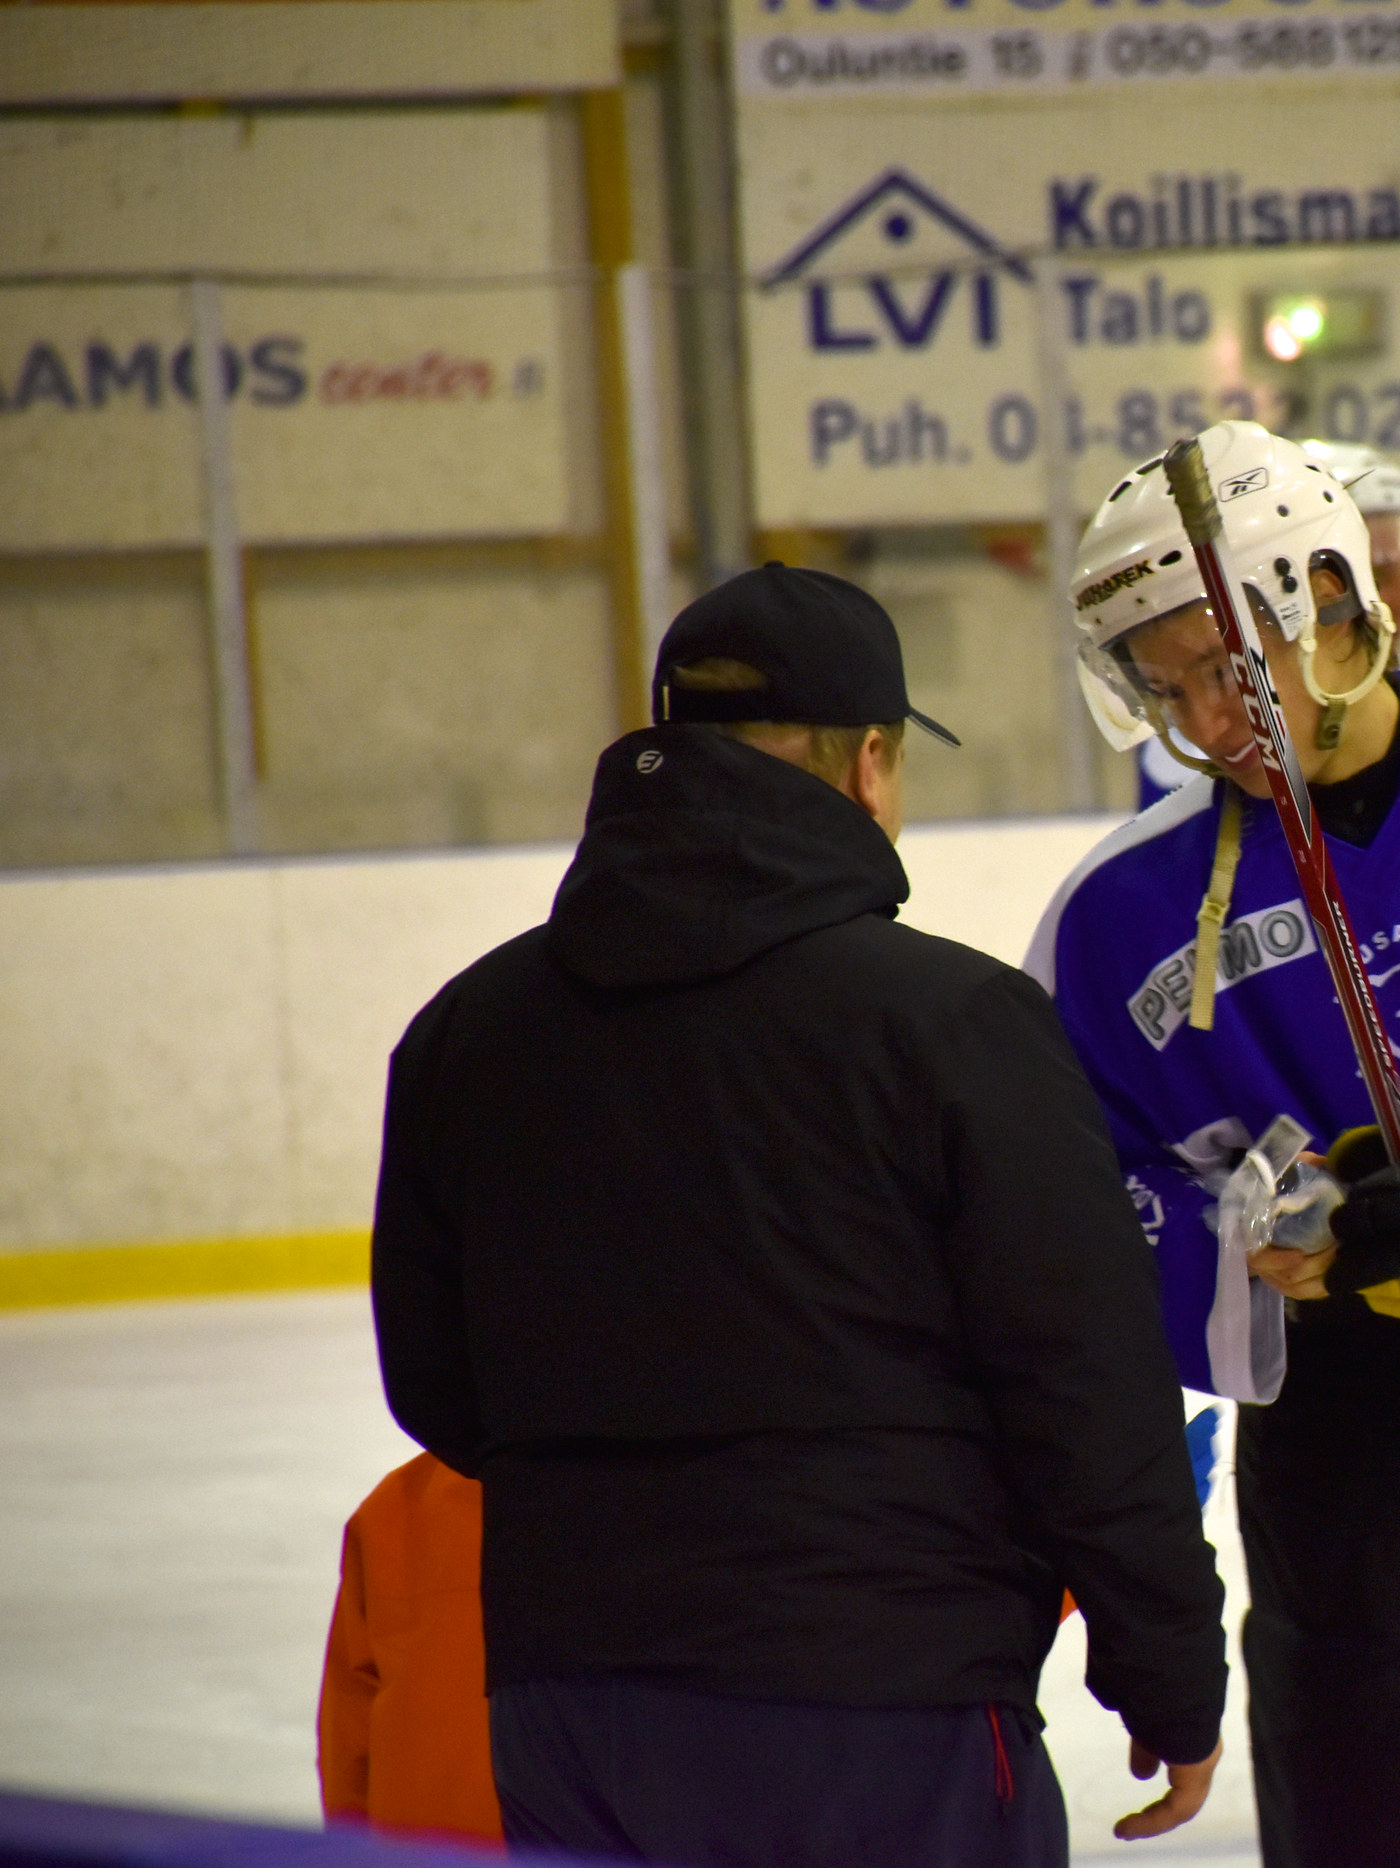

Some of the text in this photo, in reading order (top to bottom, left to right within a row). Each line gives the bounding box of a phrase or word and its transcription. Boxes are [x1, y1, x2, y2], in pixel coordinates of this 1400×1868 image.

[990, 28, 1043, 81] 15
[808, 272, 997, 352] LVI
[1060, 275, 1212, 348] Talo
[0, 333, 308, 413] AMOS
[806, 394, 972, 468] Puh.
[1229, 650, 1281, 773] CCM
[1128, 909, 1305, 1043] PEMO
[1332, 900, 1392, 1068] SPEEDBURNER
